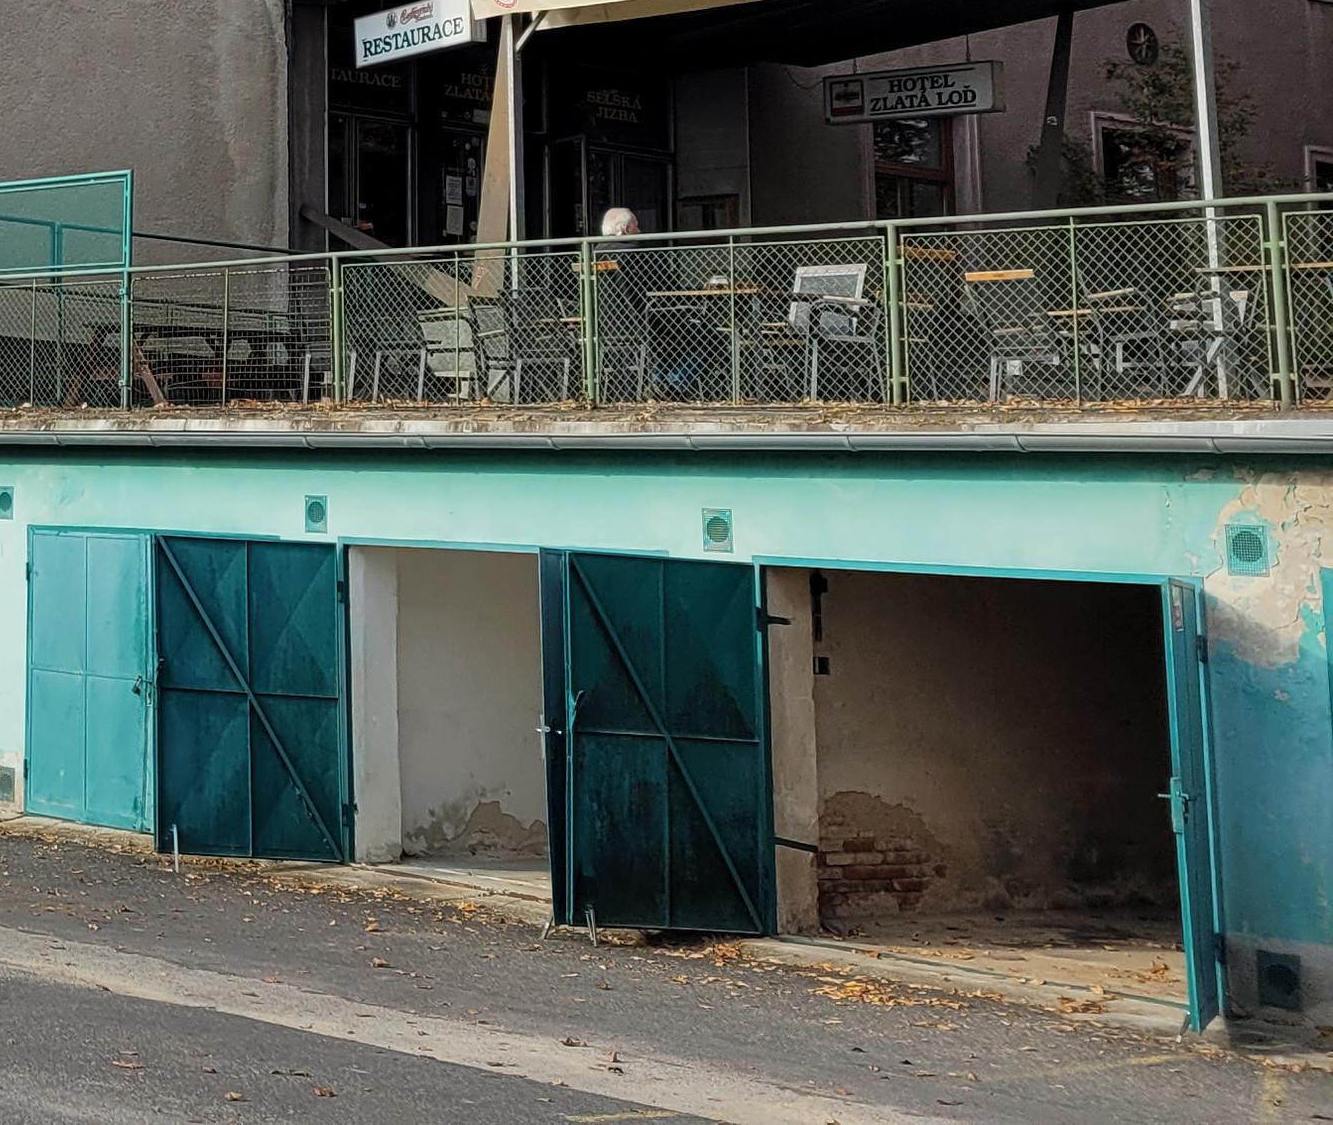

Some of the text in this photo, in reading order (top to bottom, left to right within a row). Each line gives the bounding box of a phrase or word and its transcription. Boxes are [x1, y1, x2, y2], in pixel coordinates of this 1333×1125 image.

[362, 17, 465, 59] RESTAURACE
[329, 68, 402, 88] TAURACE
[461, 73, 494, 87] HOT
[888, 74, 956, 94] HOTEL
[869, 88, 931, 113] ZLATÁ
[936, 85, 977, 106] LOĎ
